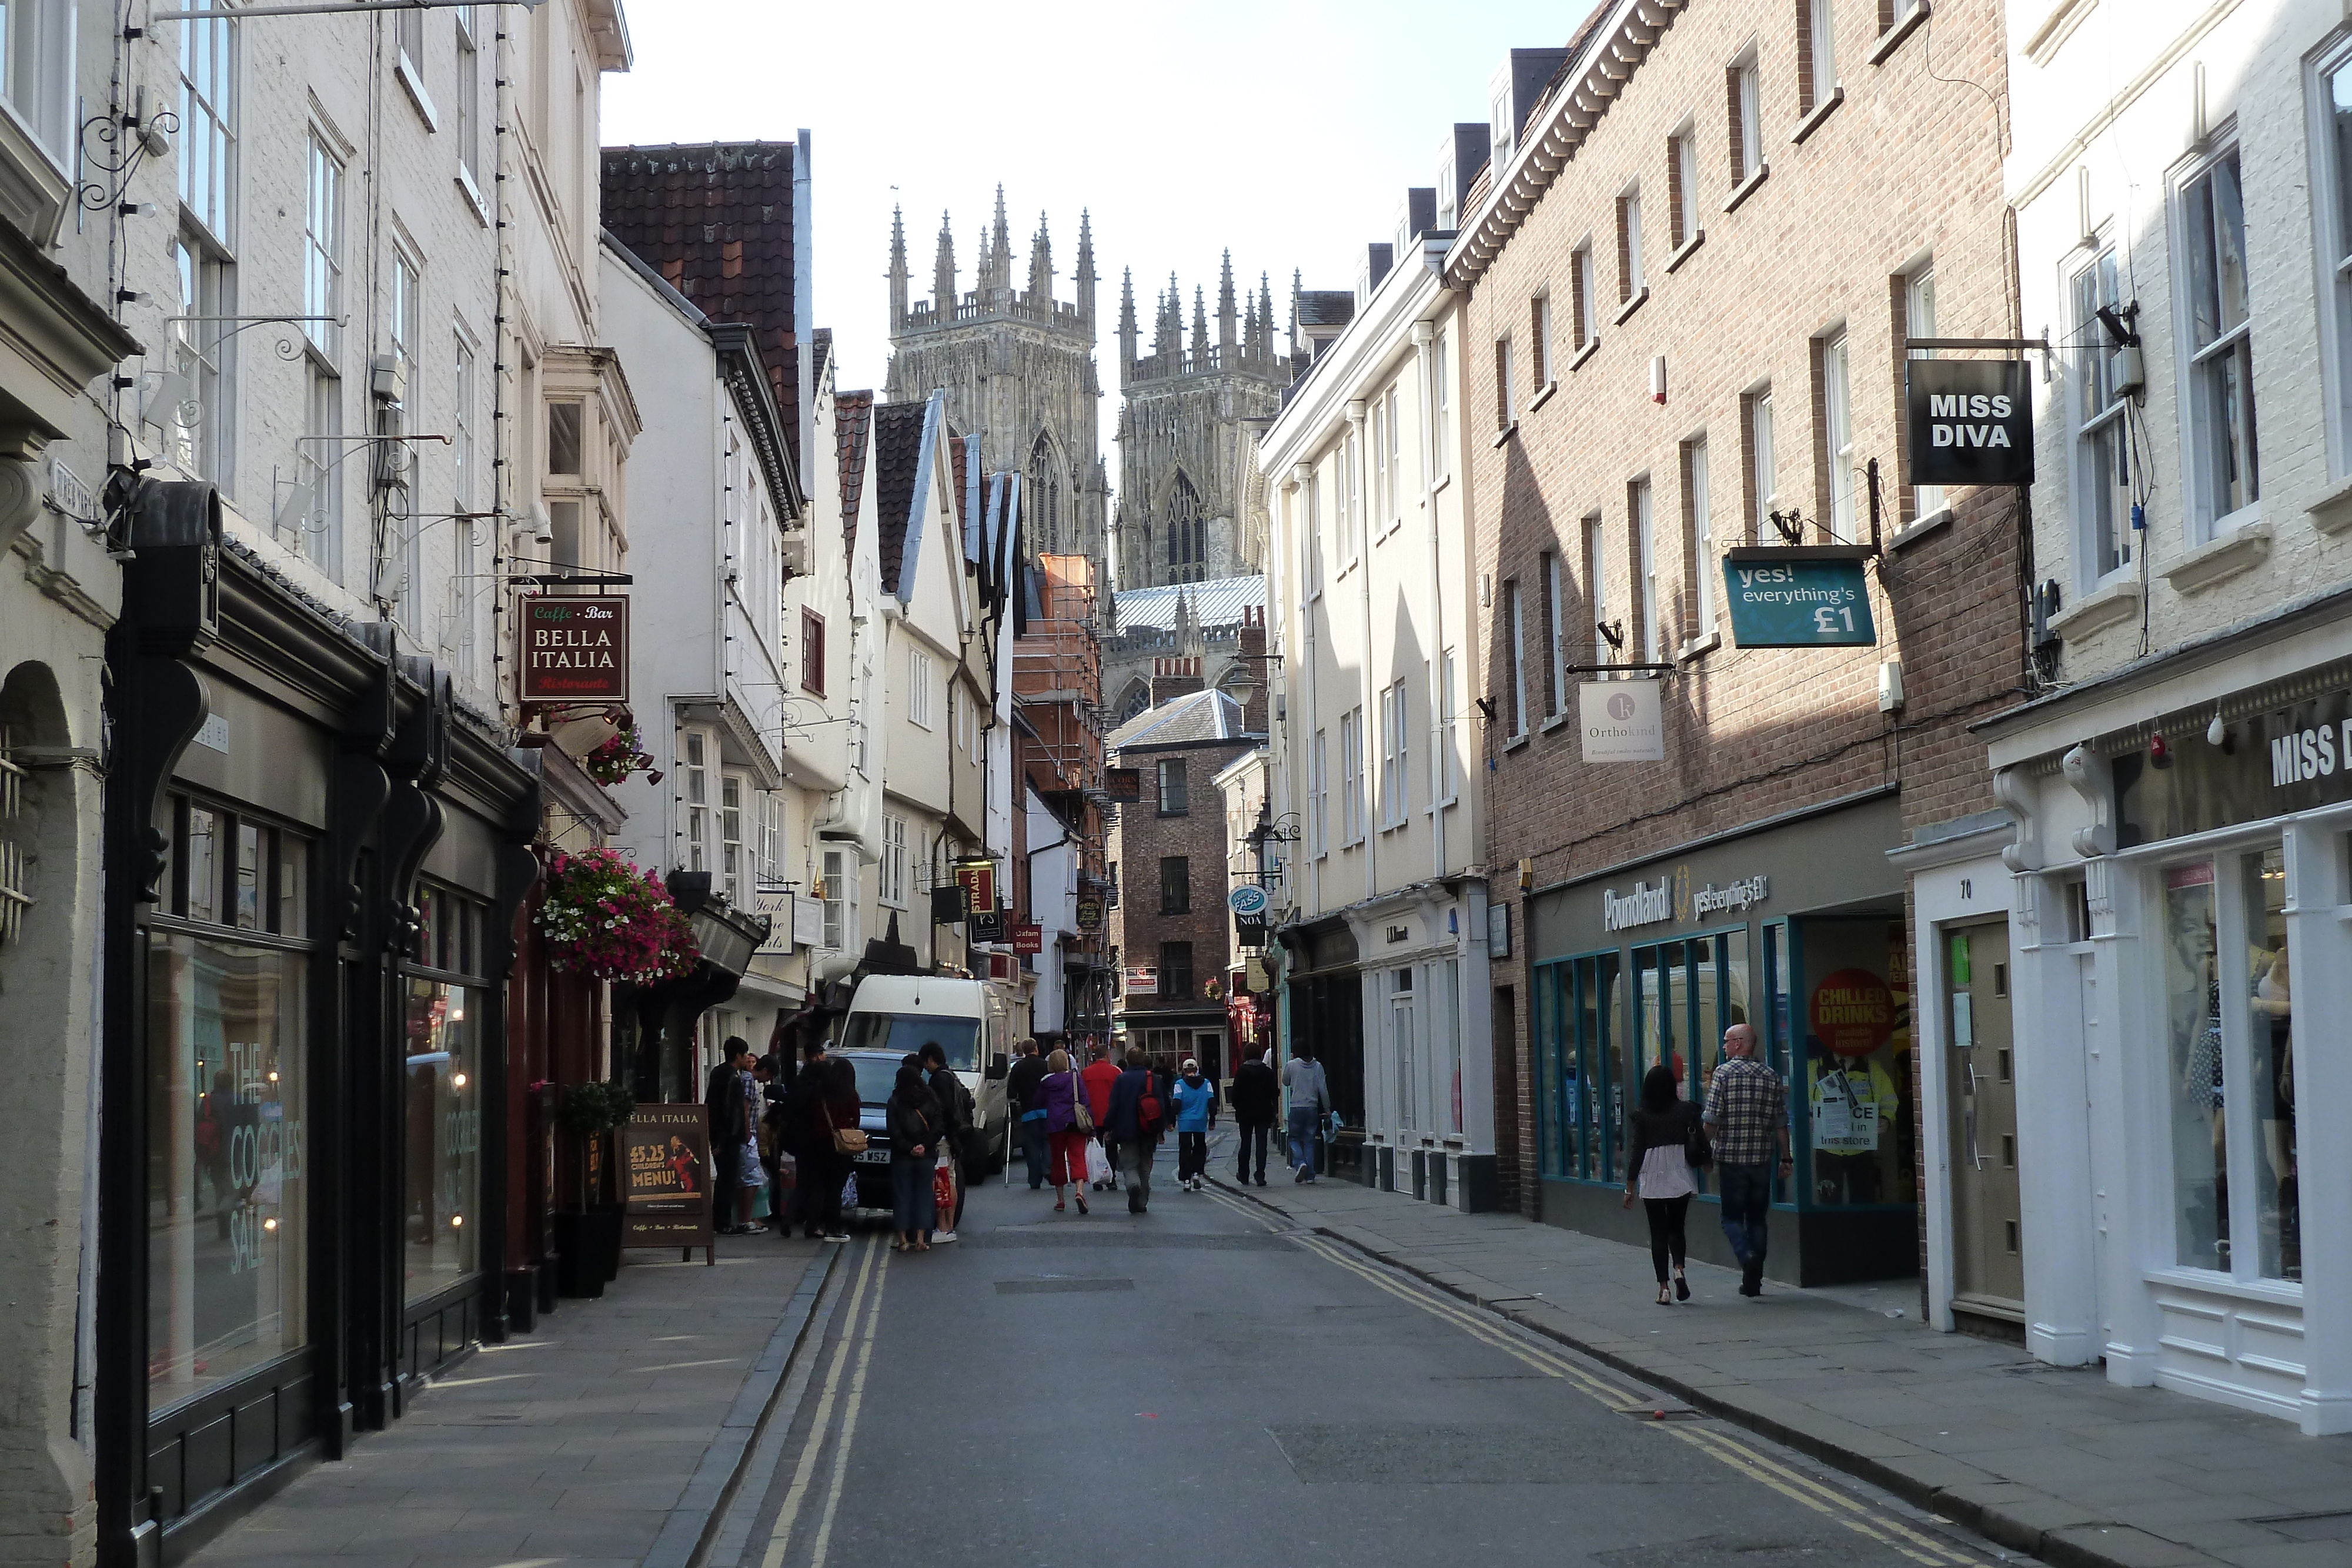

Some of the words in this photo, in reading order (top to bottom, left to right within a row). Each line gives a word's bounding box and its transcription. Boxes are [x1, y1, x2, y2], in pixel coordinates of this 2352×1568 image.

[1930, 394, 2012, 418] MISS
[1932, 424, 2012, 448] DIVA
[1738, 564, 1794, 589] yes!
[1742, 587, 1856, 605] everything's
[534, 606, 573, 623] Caffe
[584, 606, 614, 619] Bar
[1813, 606, 1855, 633] £1
[534, 629, 612, 647] BELLA
[532, 651, 615, 668] ITALIA
[538, 676, 609, 689] Ristorante
[1589, 724, 1655, 738] Orthokind
[2271, 724, 2336, 787] MISS
[970, 870, 981, 912] STRADA
[1234, 891, 1247, 901] vom
[756, 897, 784, 912] York
[1235, 891, 1260, 912] FASS
[1604, 875, 1672, 932] Poundland
[1693, 883, 1712, 922] yes!
[1711, 878, 1755, 914] everything's
[1240, 915, 1261, 926] NOA
[1818, 988, 1885, 1006] CHILLED
[1819, 1004, 1888, 1024] DRINKS
[230, 1042, 262, 1105] THE
[628, 1114, 657, 1124] ELLA
[662, 1114, 699, 1124] ITALIA
[629, 1144, 665, 1164] £5.25
[631, 1161, 665, 1171] CHILDREN'S
[632, 1169, 677, 1188] MENU!
[230, 1204, 266, 1275] SALE
